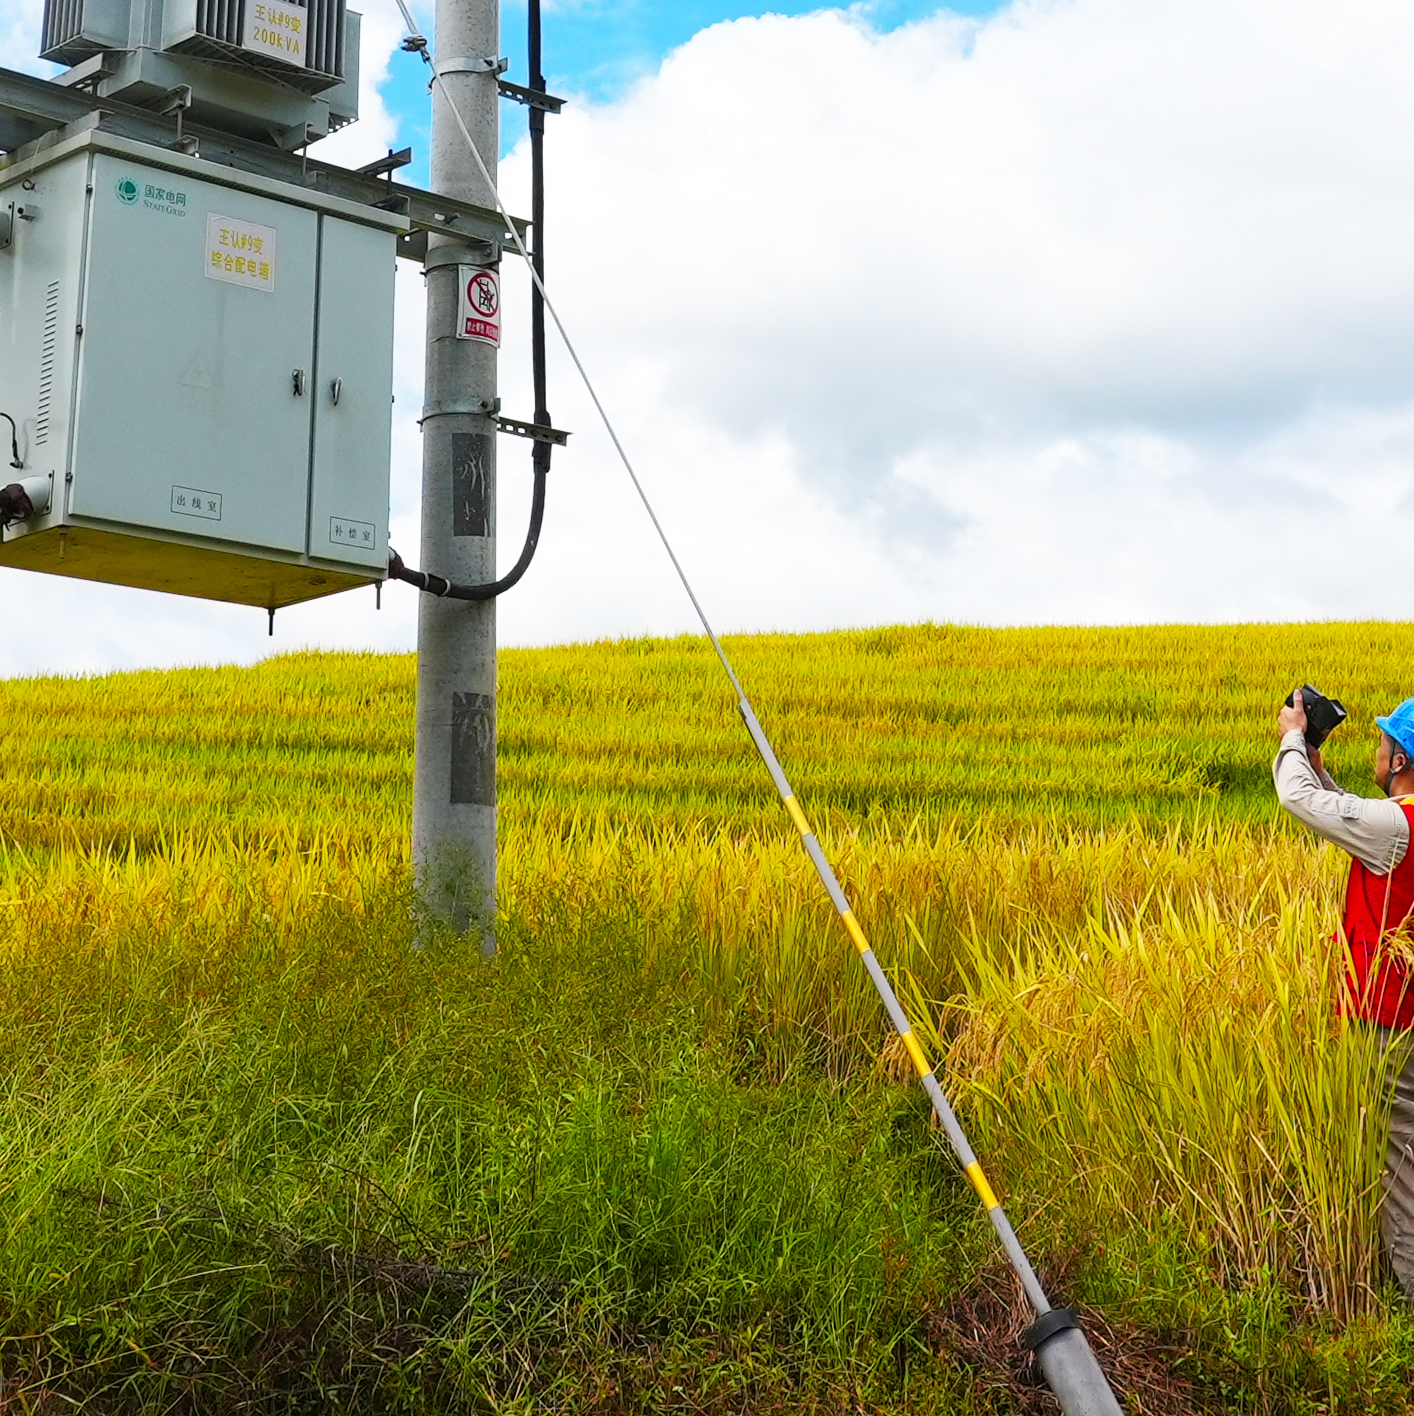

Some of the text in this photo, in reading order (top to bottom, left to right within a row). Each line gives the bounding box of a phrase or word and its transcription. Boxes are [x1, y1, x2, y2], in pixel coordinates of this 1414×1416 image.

[253, 26, 300, 54] 200kVA
[144, 184, 186, 207] 国家电网
[211, 250, 270, 281] 综合配电箱
[176, 494, 217, 513] 出线室
